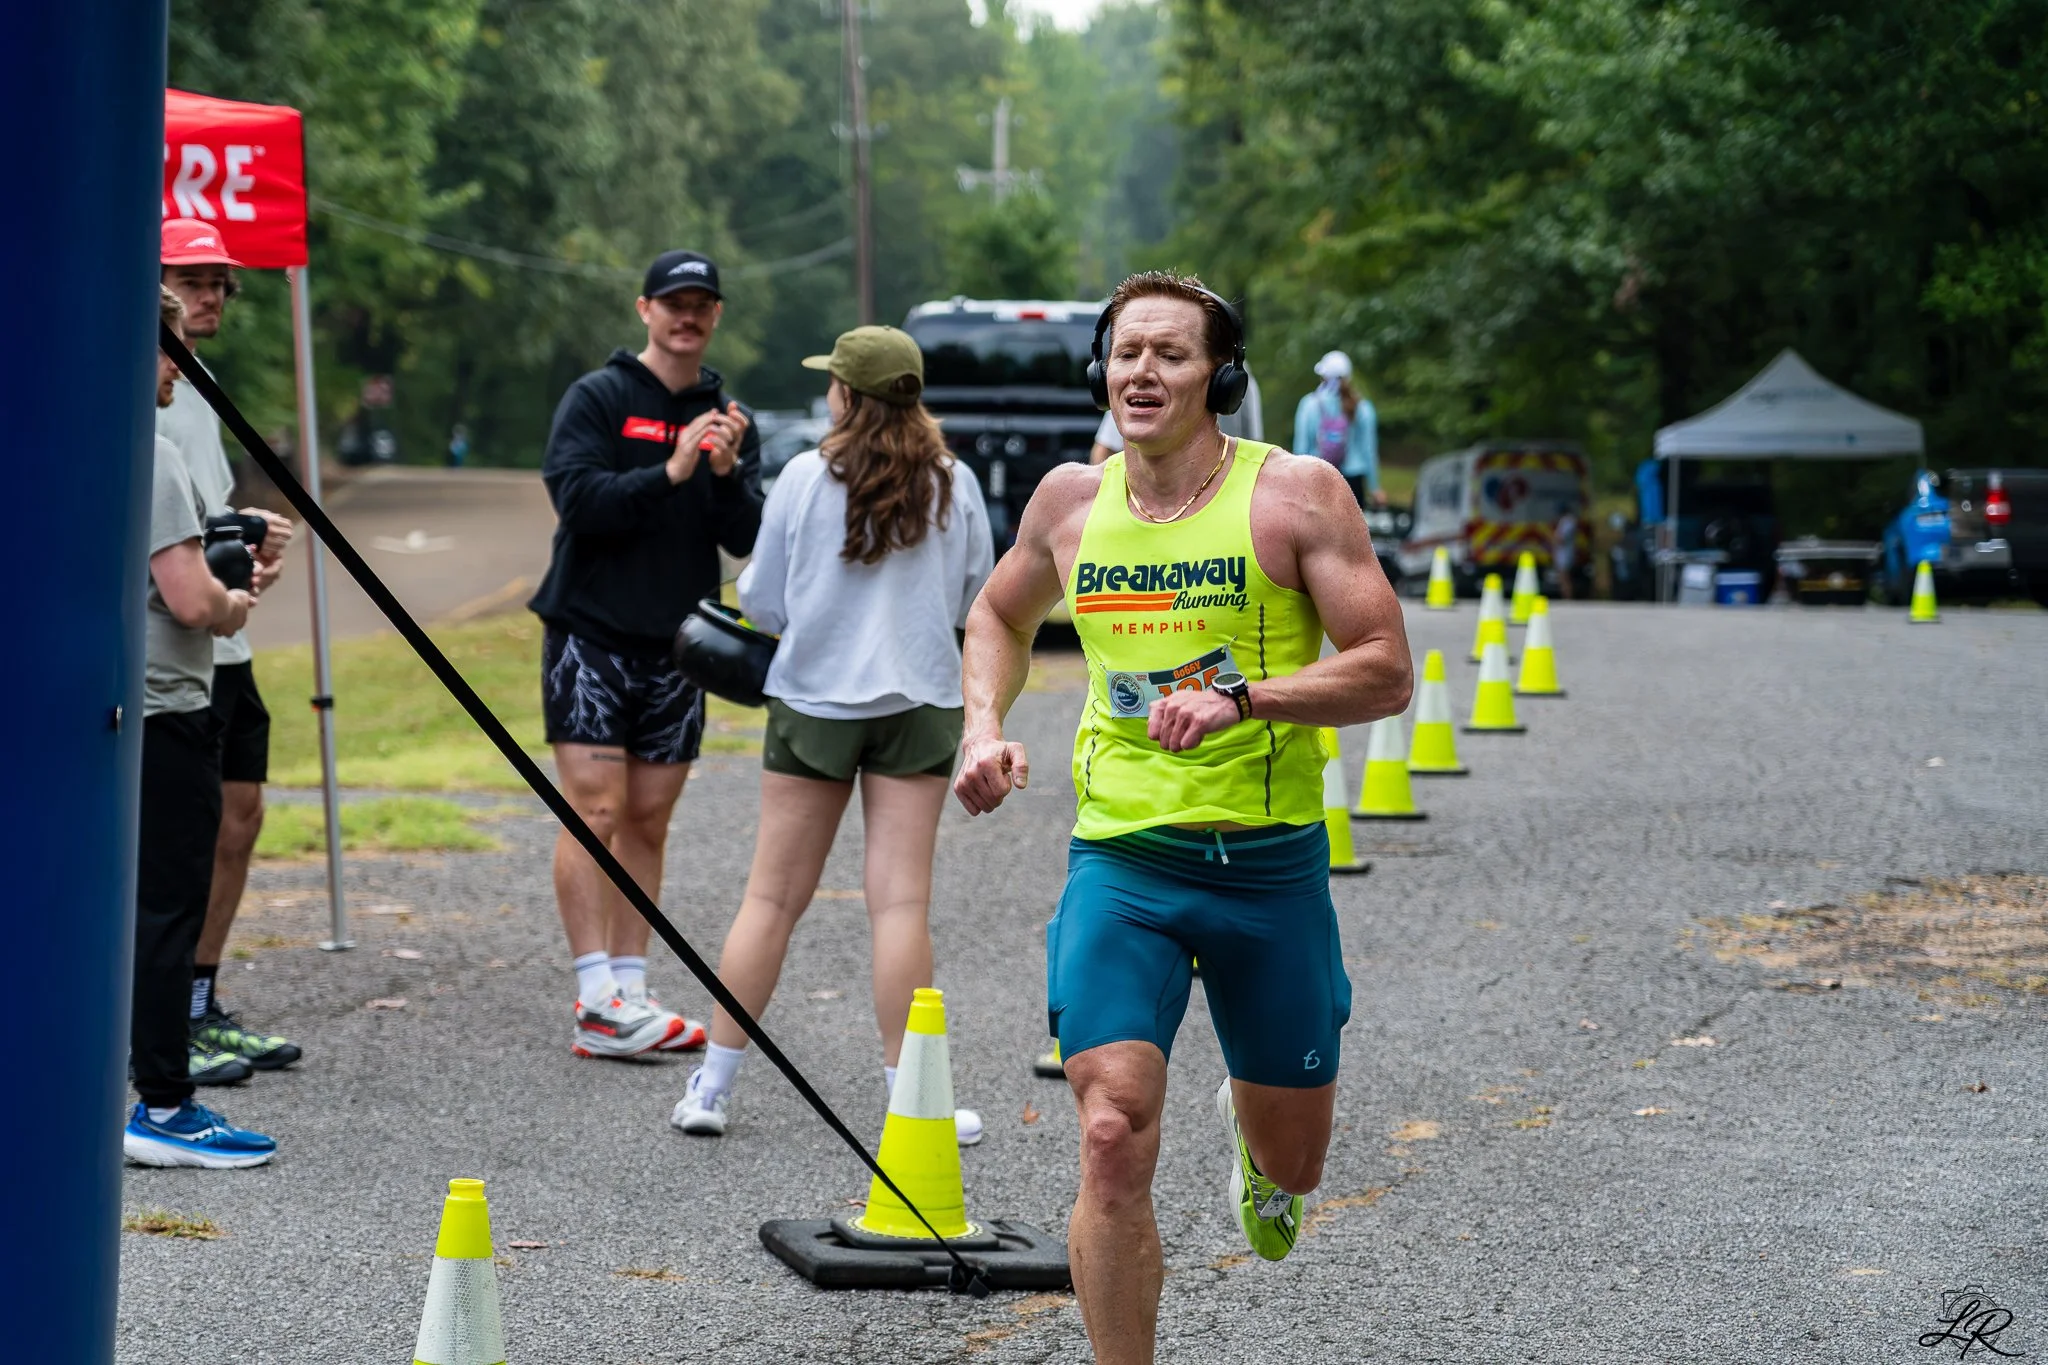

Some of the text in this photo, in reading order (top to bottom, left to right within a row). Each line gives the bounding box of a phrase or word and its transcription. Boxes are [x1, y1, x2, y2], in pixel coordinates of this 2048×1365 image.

[163, 143, 257, 221] RE
[1076, 557, 1246, 594] Breakaway
[1172, 587, 1249, 611] Running
[1112, 619, 1206, 635] MEMPHIS
